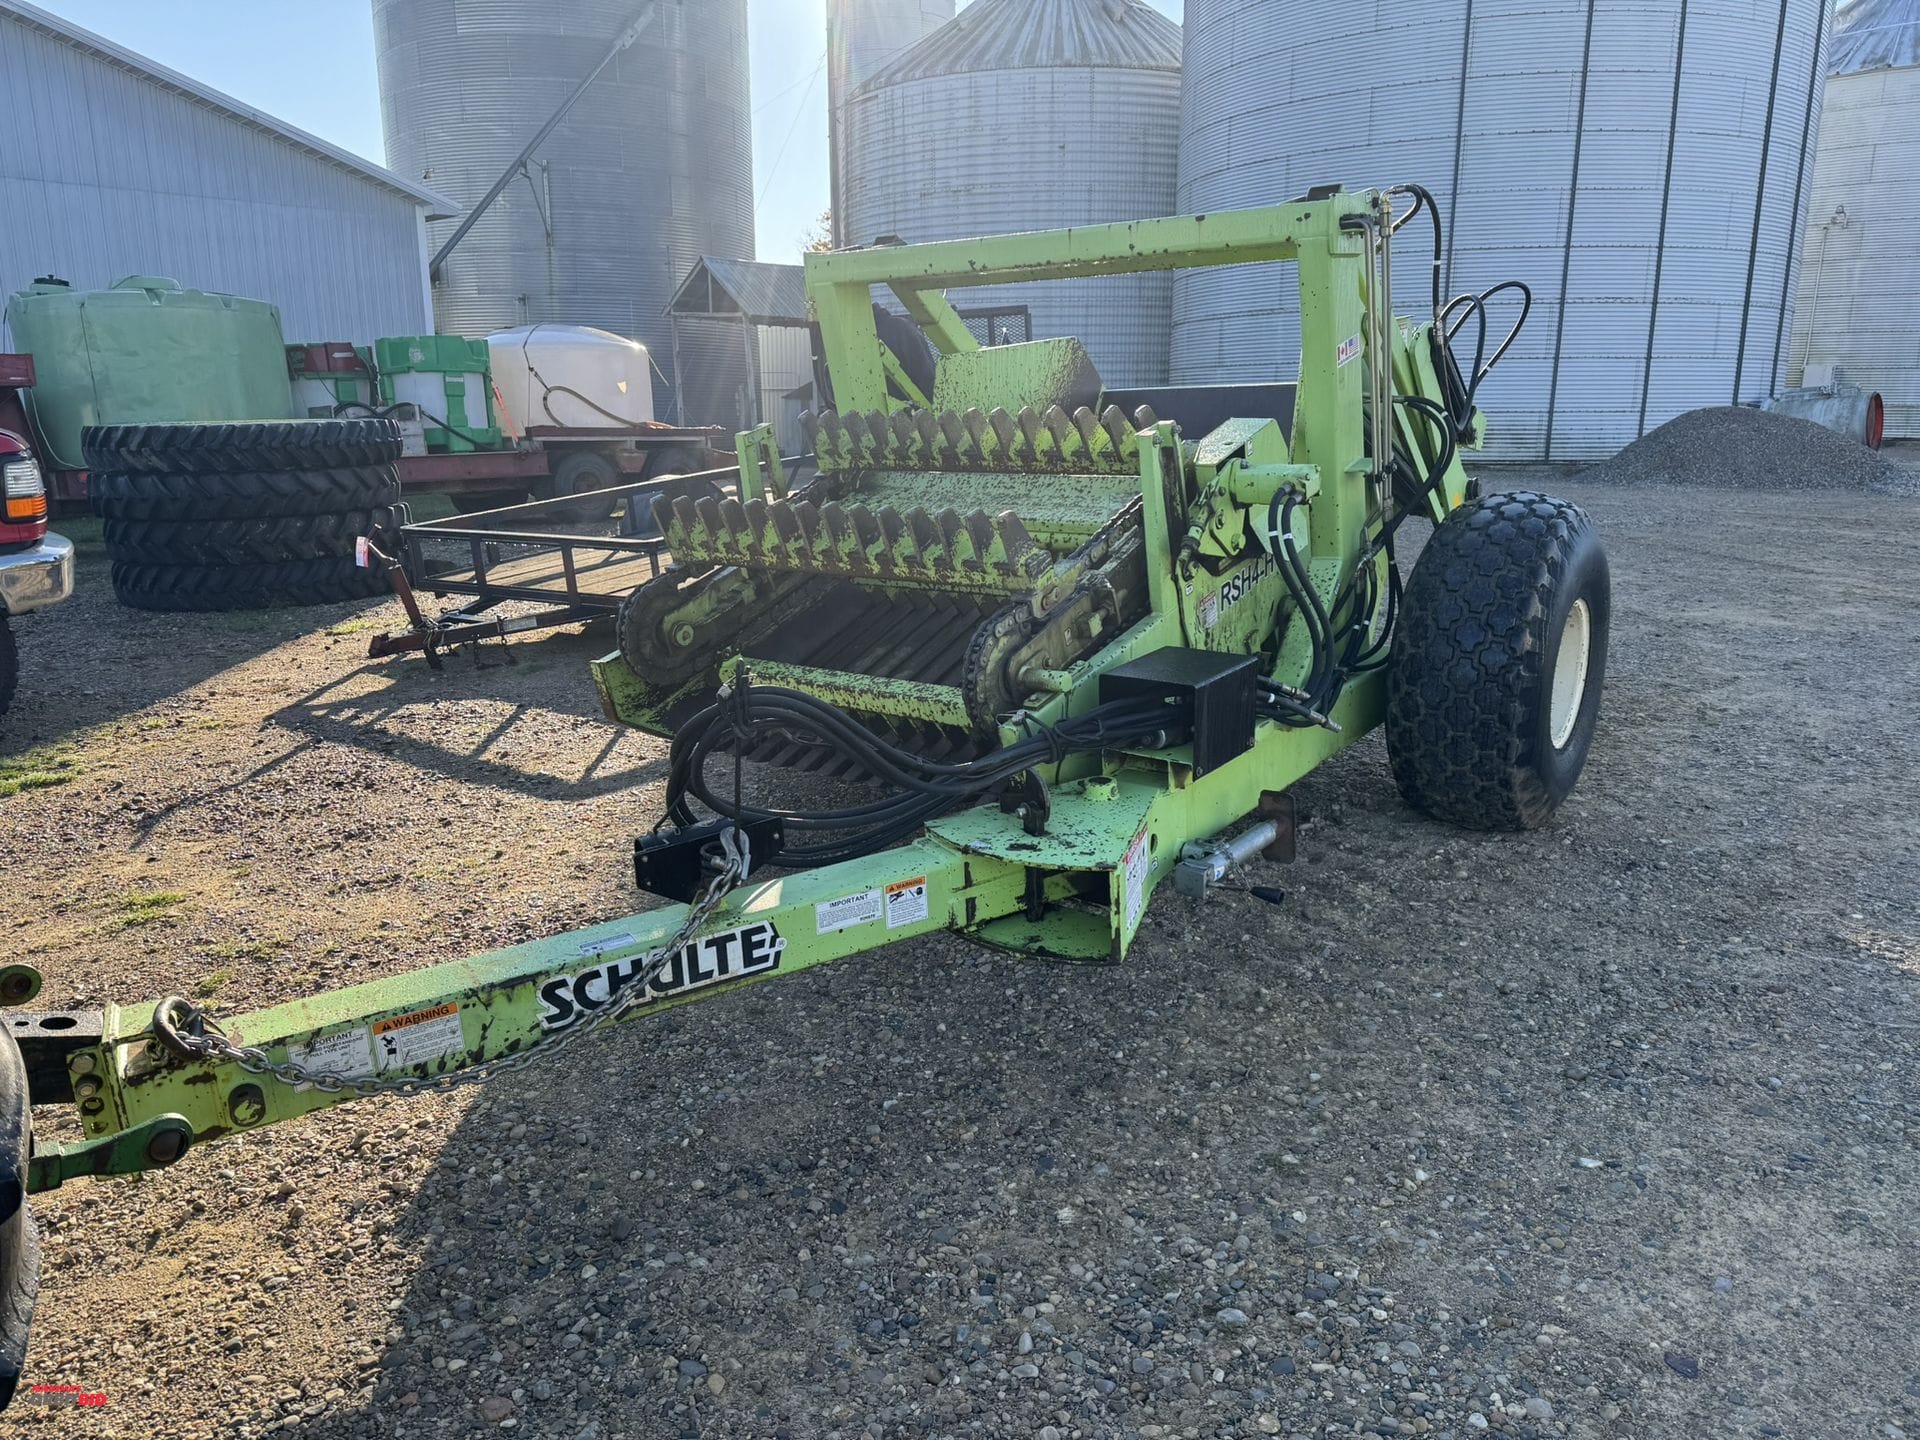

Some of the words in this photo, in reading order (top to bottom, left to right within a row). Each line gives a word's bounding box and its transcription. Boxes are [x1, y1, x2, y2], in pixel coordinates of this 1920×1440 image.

[896, 879, 923, 890] WARNING
[829, 894, 869, 908] IMPORTANT
[541, 923, 782, 1025] SCHULTE
[392, 1006, 449, 1028] WARNING
[303, 1031, 353, 1049] IMPORTANT
